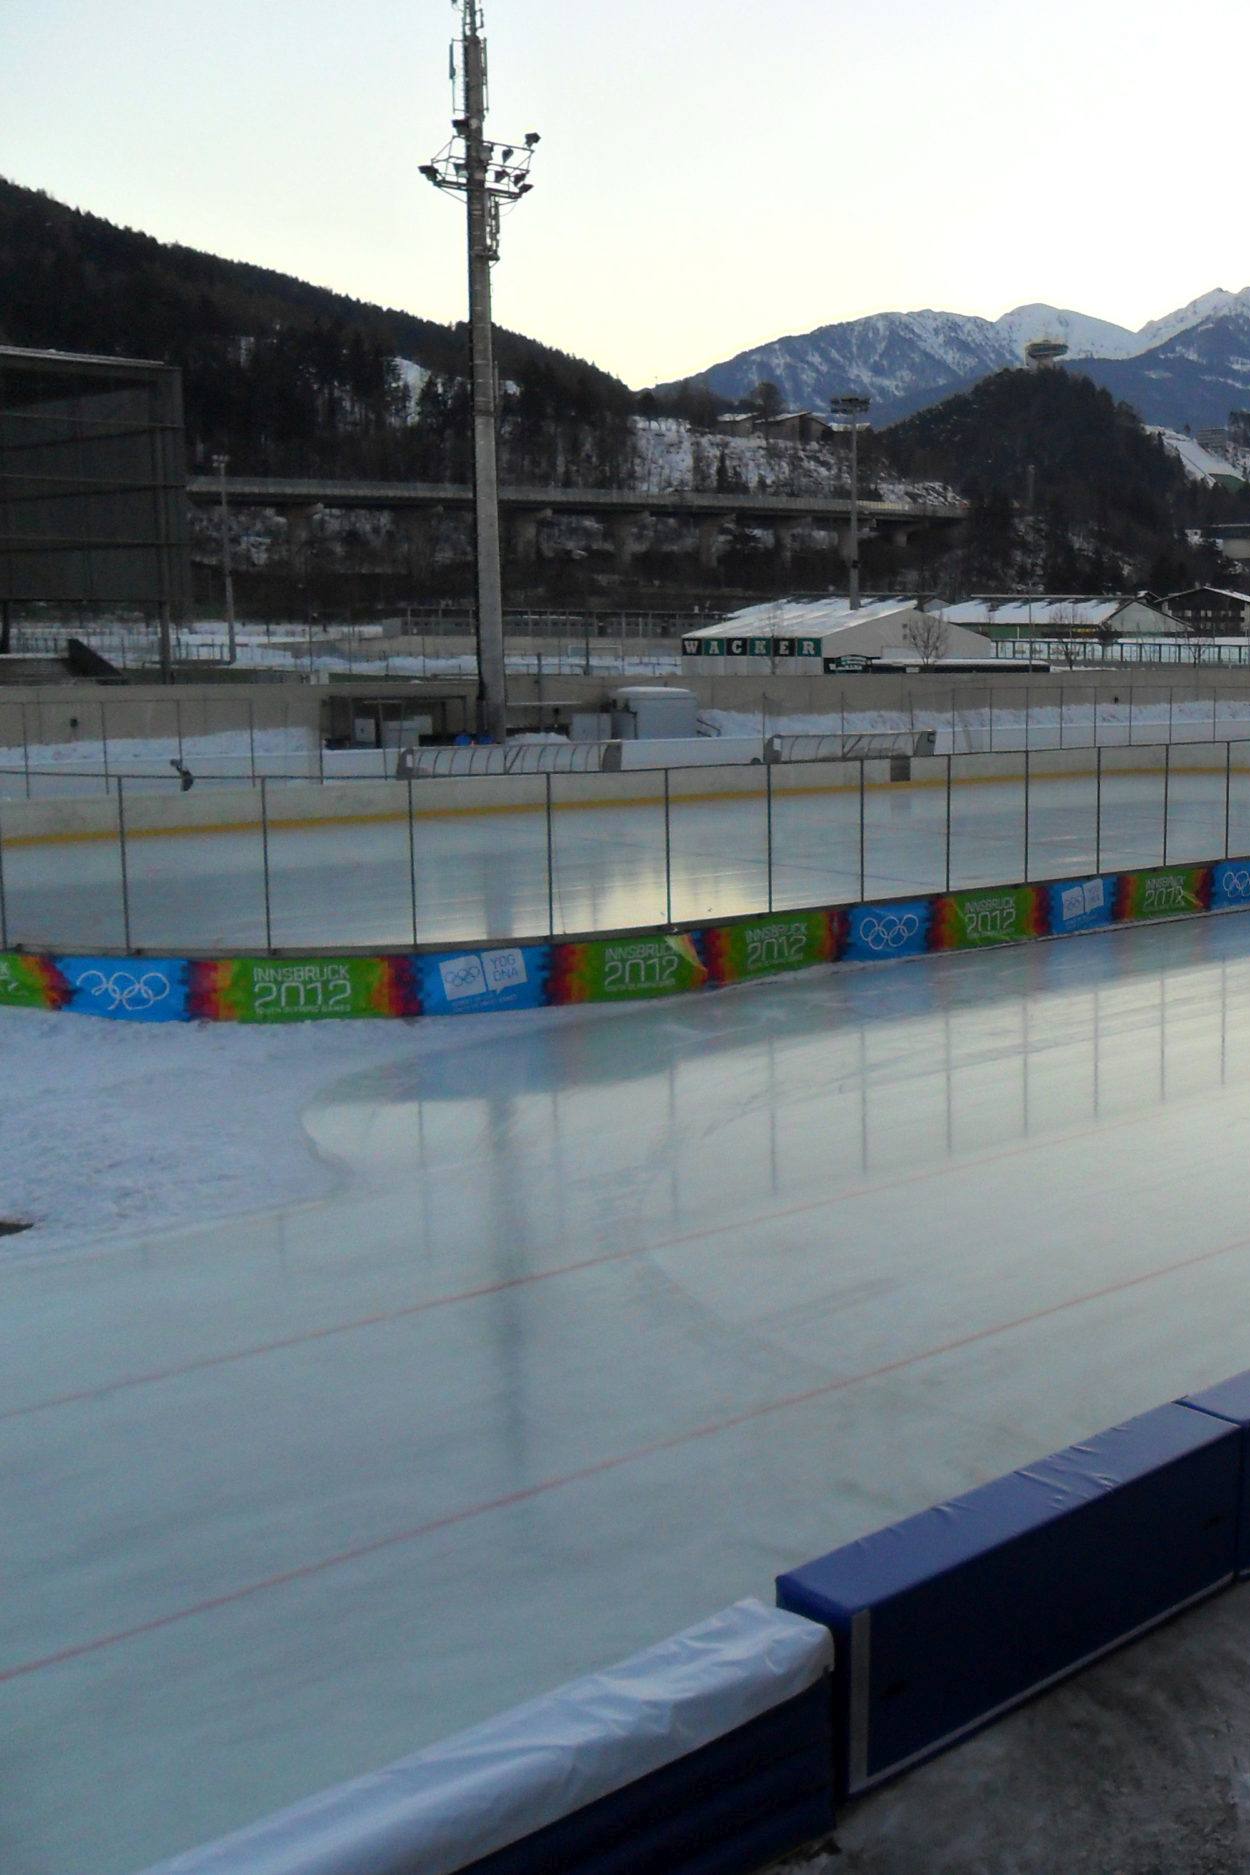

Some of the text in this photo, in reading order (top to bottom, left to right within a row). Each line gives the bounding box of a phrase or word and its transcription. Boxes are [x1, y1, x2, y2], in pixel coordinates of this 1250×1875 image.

[684, 640, 815, 655] WACKER
[965, 908, 1016, 933] 2012
[604, 942, 675, 961] INNSBRUC
[746, 936, 807, 968] 2012
[253, 965, 351, 982] INNSBRUCK
[604, 955, 678, 992] 2012
[253, 979, 352, 1008] 2012
